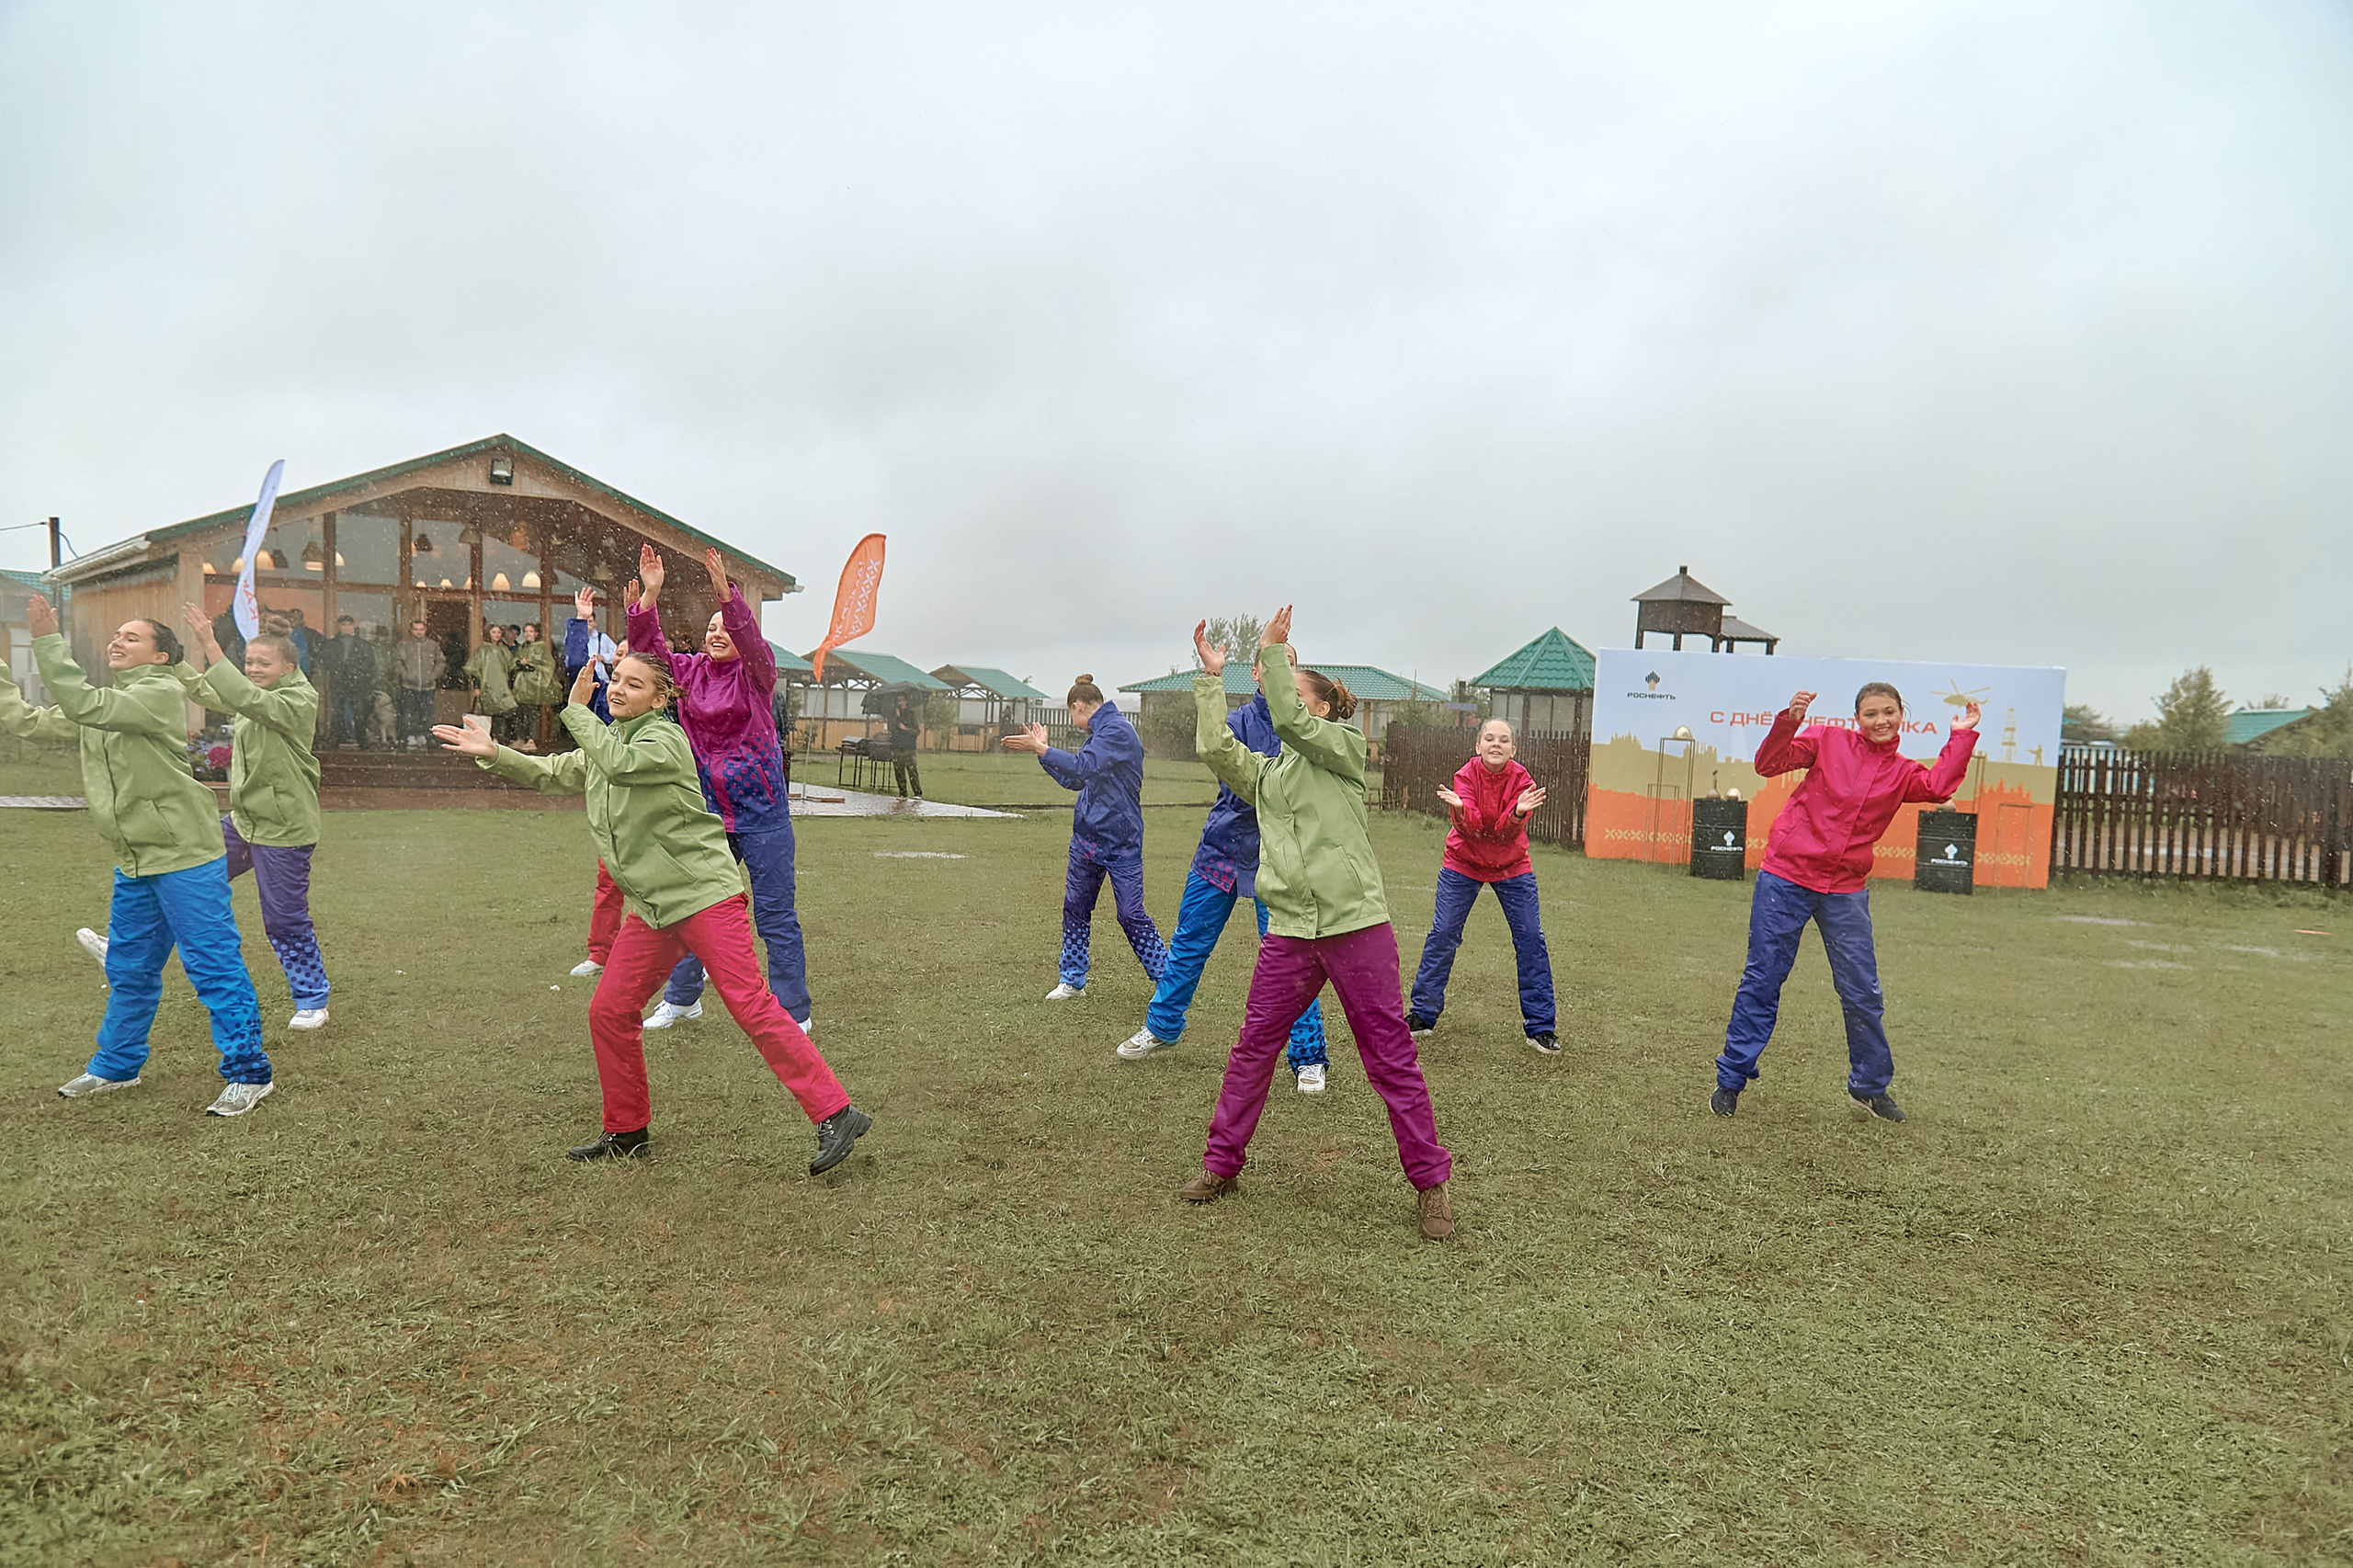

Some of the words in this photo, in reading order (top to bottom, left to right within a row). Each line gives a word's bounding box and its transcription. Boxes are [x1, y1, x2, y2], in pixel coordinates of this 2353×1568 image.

[1626, 691, 1677, 700] РОСНЕФТЬ
[1710, 710, 1724, 723] С
[1730, 710, 1779, 727] ДНЁ
